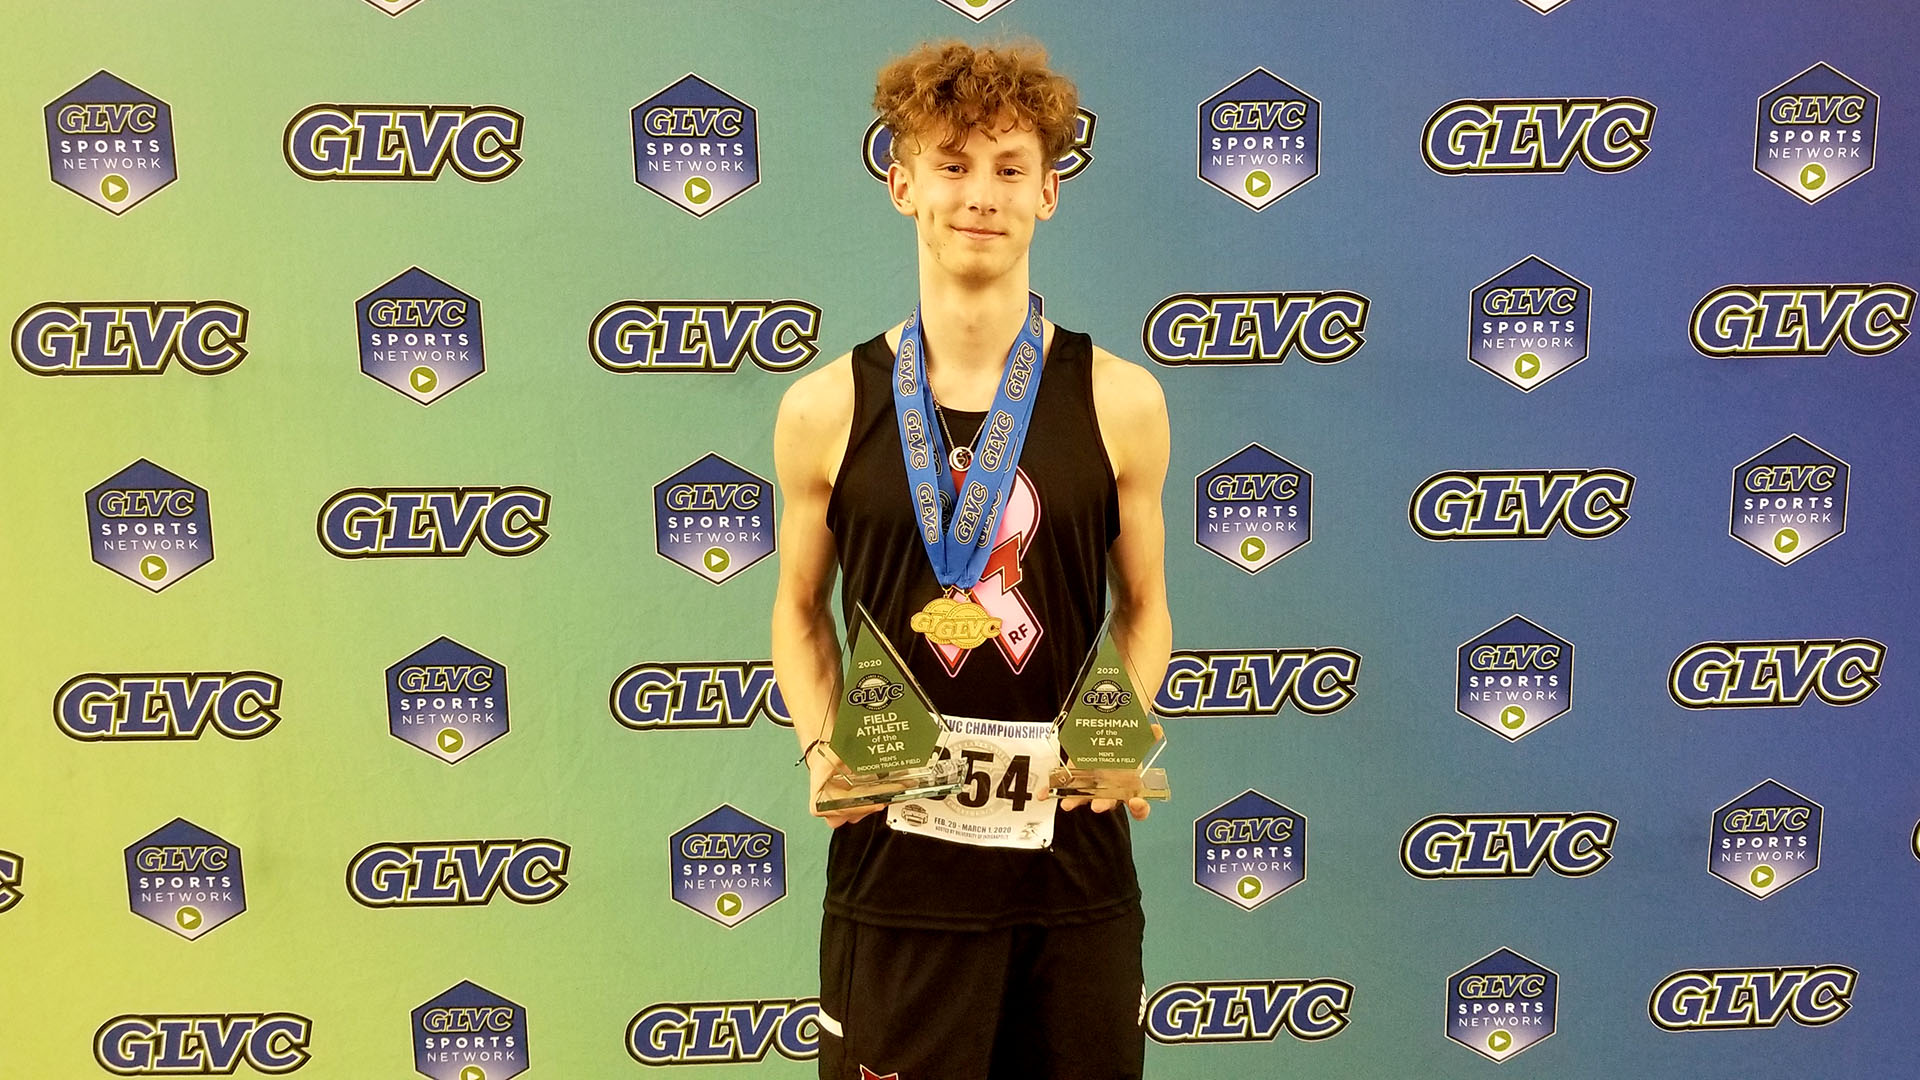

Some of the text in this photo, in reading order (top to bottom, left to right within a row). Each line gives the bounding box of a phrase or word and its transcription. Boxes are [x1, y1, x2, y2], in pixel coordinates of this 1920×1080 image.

[1210, 101, 1307, 131] GLVC
[1768, 96, 1866, 125] GLVC
[57, 105, 158, 134] GLVC
[643, 108, 743, 137] GLVC
[287, 107, 520, 180] GLVC
[1212, 136, 1305, 151] SPORTS
[1424, 101, 1654, 172] GLVC
[1769, 129, 1862, 144] SPORTS
[60, 139, 161, 154] SPORTS
[646, 143, 745, 157] SPORTS
[1768, 146, 1861, 160] NETWORK
[62, 157, 162, 171] NETWORK
[648, 160, 745, 173] NETWORK
[1212, 153, 1304, 166] NETWORK
[1481, 287, 1578, 316] GLVC
[368, 299, 469, 328] GLVC
[1692, 287, 1914, 355] GLVC
[1146, 296, 1368, 362] GLVC
[1482, 320, 1576, 335] SPORTS
[15, 304, 246, 373] GLVC
[371, 333, 469, 347] SPORTS
[592, 303, 820, 371] GLVC
[1482, 336, 1575, 350] NETWORK
[373, 349, 471, 362] NETWORK
[898, 339, 918, 397] GLVC
[1005, 341, 1036, 401] GLVC
[903, 409, 928, 470] GLVC
[980, 410, 1014, 472] GLVC
[1743, 464, 1837, 492] GLVC
[1207, 473, 1300, 501] GLVC
[98, 489, 196, 517] GLVC
[665, 482, 762, 512] GLVC
[1412, 472, 1634, 538] GLVC
[1744, 496, 1834, 510] SPORTS
[916, 482, 939, 544] GLVC
[955, 481, 988, 544] GLVC
[1208, 505, 1298, 519] SPORTS
[1743, 511, 1832, 525] NETWORK
[101, 523, 199, 536] SPORTS
[320, 489, 549, 556] GLVC
[668, 515, 762, 529] SPORTS
[1208, 521, 1297, 533] NETWORK
[103, 538, 200, 551] NETWORK
[669, 531, 761, 544] NETWORK
[935, 618, 1002, 639] GLVC
[1008, 623, 1029, 645] RF
[858, 659, 882, 669] 2020
[1468, 644, 1561, 672] GLVC
[398, 665, 494, 693] GLVC
[1097, 667, 1119, 675] 2020
[1671, 642, 1885, 707] GLVC
[1153, 651, 1361, 716] GLVC
[1469, 674, 1559, 688] SPORTS
[848, 683, 904, 706] GLVC
[1082, 691, 1132, 707] GLVC
[1469, 690, 1558, 702] NETWORK
[57, 674, 281, 739] GLVC
[400, 697, 495, 710] SPORTS
[402, 712, 495, 725] NETWORK
[863, 712, 898, 725] FIELD
[1075, 718, 1139, 728] FRESHMAN
[856, 721, 910, 737] ATHLETE
[965, 721, 1051, 740] CHAMPIONSHIPS
[872, 734, 897, 743] of the
[1090, 737, 1123, 747] YEAR
[867, 742, 905, 755] YEAR
[880, 761, 899, 769] TRACK
[930, 746, 1032, 811] 54
[1722, 806, 1811, 834] GLVC
[962, 823, 987, 834] MARCH
[993, 826, 1012, 834] 2020
[1205, 816, 1294, 845] GLVC
[680, 832, 772, 860] GLVC
[1403, 814, 1616, 877] GLVC
[1721, 836, 1808, 850] SPORTS
[135, 844, 230, 872] GLVC
[1206, 846, 1293, 861] SPORTS
[1721, 850, 1807, 863] NETWORK
[348, 841, 568, 906] GLVC
[683, 862, 774, 877] SPORTS
[1206, 861, 1292, 874] NETWORK
[139, 876, 232, 889] SPORTS
[684, 877, 774, 890] NETWORK
[141, 890, 233, 903] NETWORK
[1457, 972, 1547, 1000] GLVC
[1651, 968, 1857, 1030] GLVC
[1146, 980, 1353, 1042] GLVC
[1458, 1002, 1544, 1016] SPORTS
[422, 1006, 515, 1034] GLVC
[1458, 1016, 1543, 1028] NETWORK
[97, 1015, 311, 1074] GLVC
[425, 1036, 515, 1050] SPORTS
[426, 1050, 515, 1064] NETWORK
